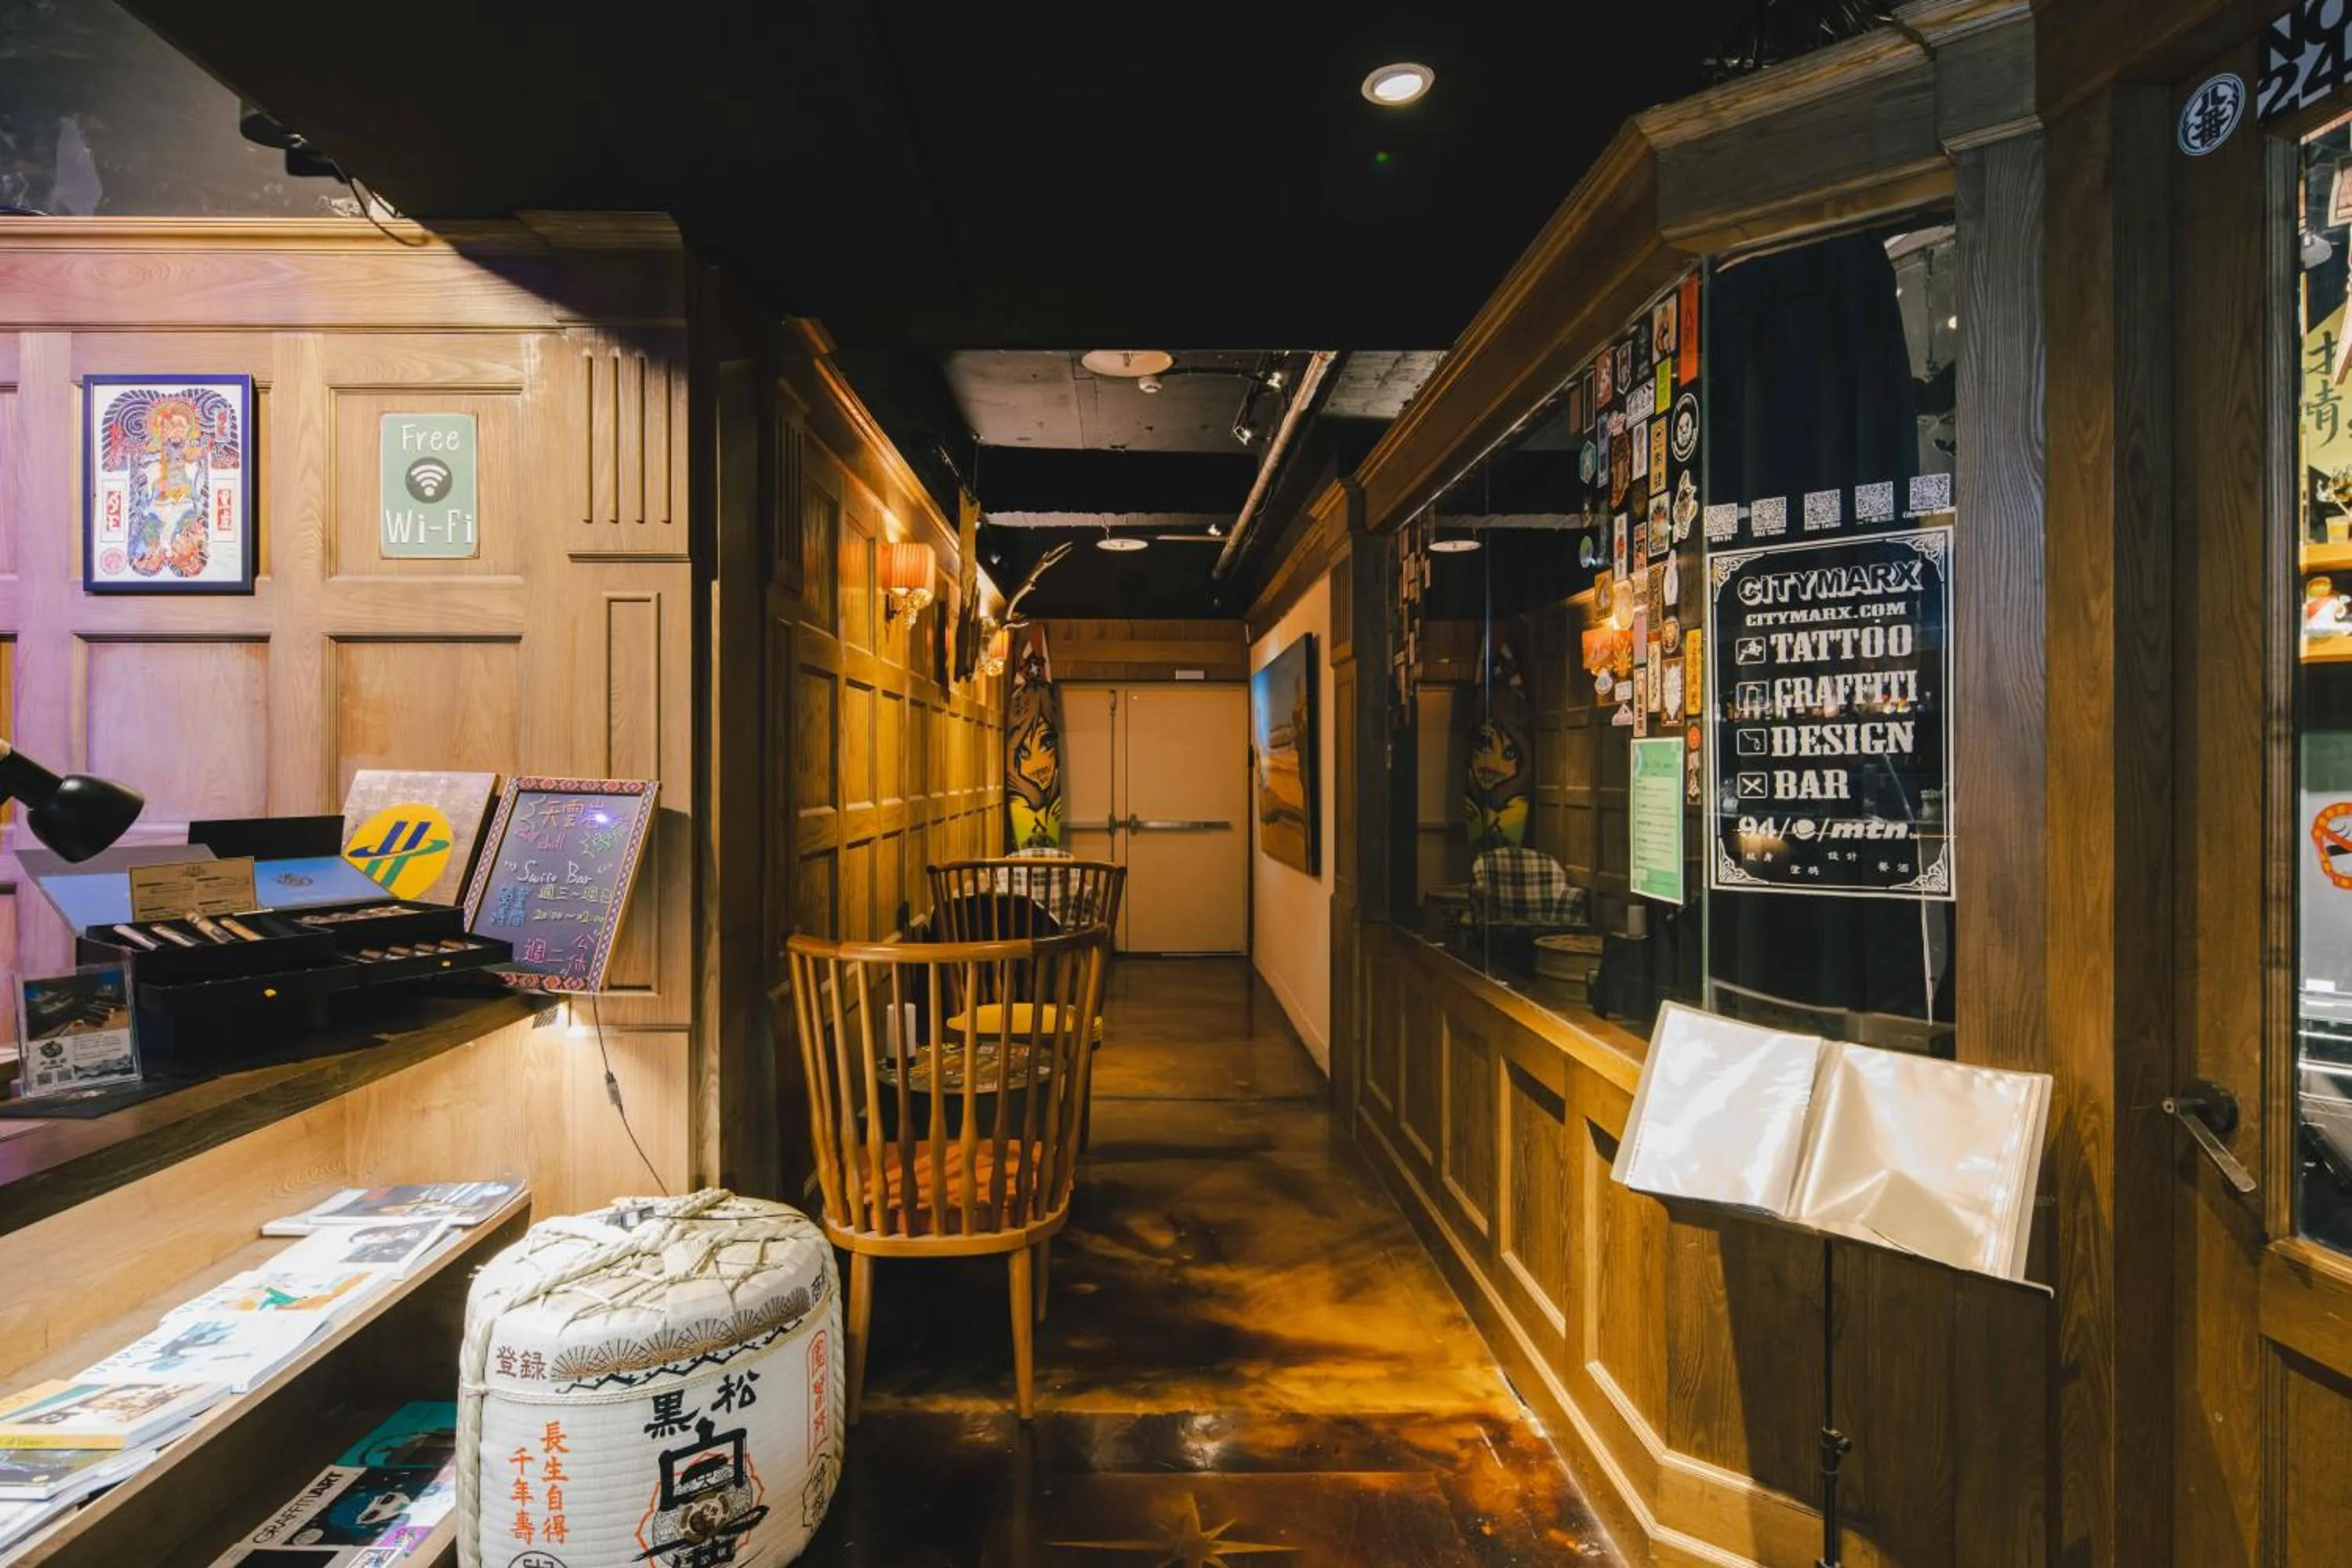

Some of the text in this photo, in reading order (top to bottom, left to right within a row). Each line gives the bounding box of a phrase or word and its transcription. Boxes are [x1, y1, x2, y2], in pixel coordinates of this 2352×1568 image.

[401, 423, 460, 451] Free
[385, 509, 474, 544] Wi-Fi
[1737, 561, 1924, 606] CITYMARX
[1745, 601, 1907, 626] CITYMARX.COM
[1769, 624, 1913, 664] TATTOO
[1774, 670, 1918, 708] GRAFFITI
[1770, 720, 1915, 757] DESIGN
[1773, 769, 1851, 800] BAR
[496, 1345, 547, 1381] 登録
[644, 1369, 761, 1439] 黒松
[509, 1446, 536, 1545] 千年壽
[539, 1420, 570, 1545] 長生自得
